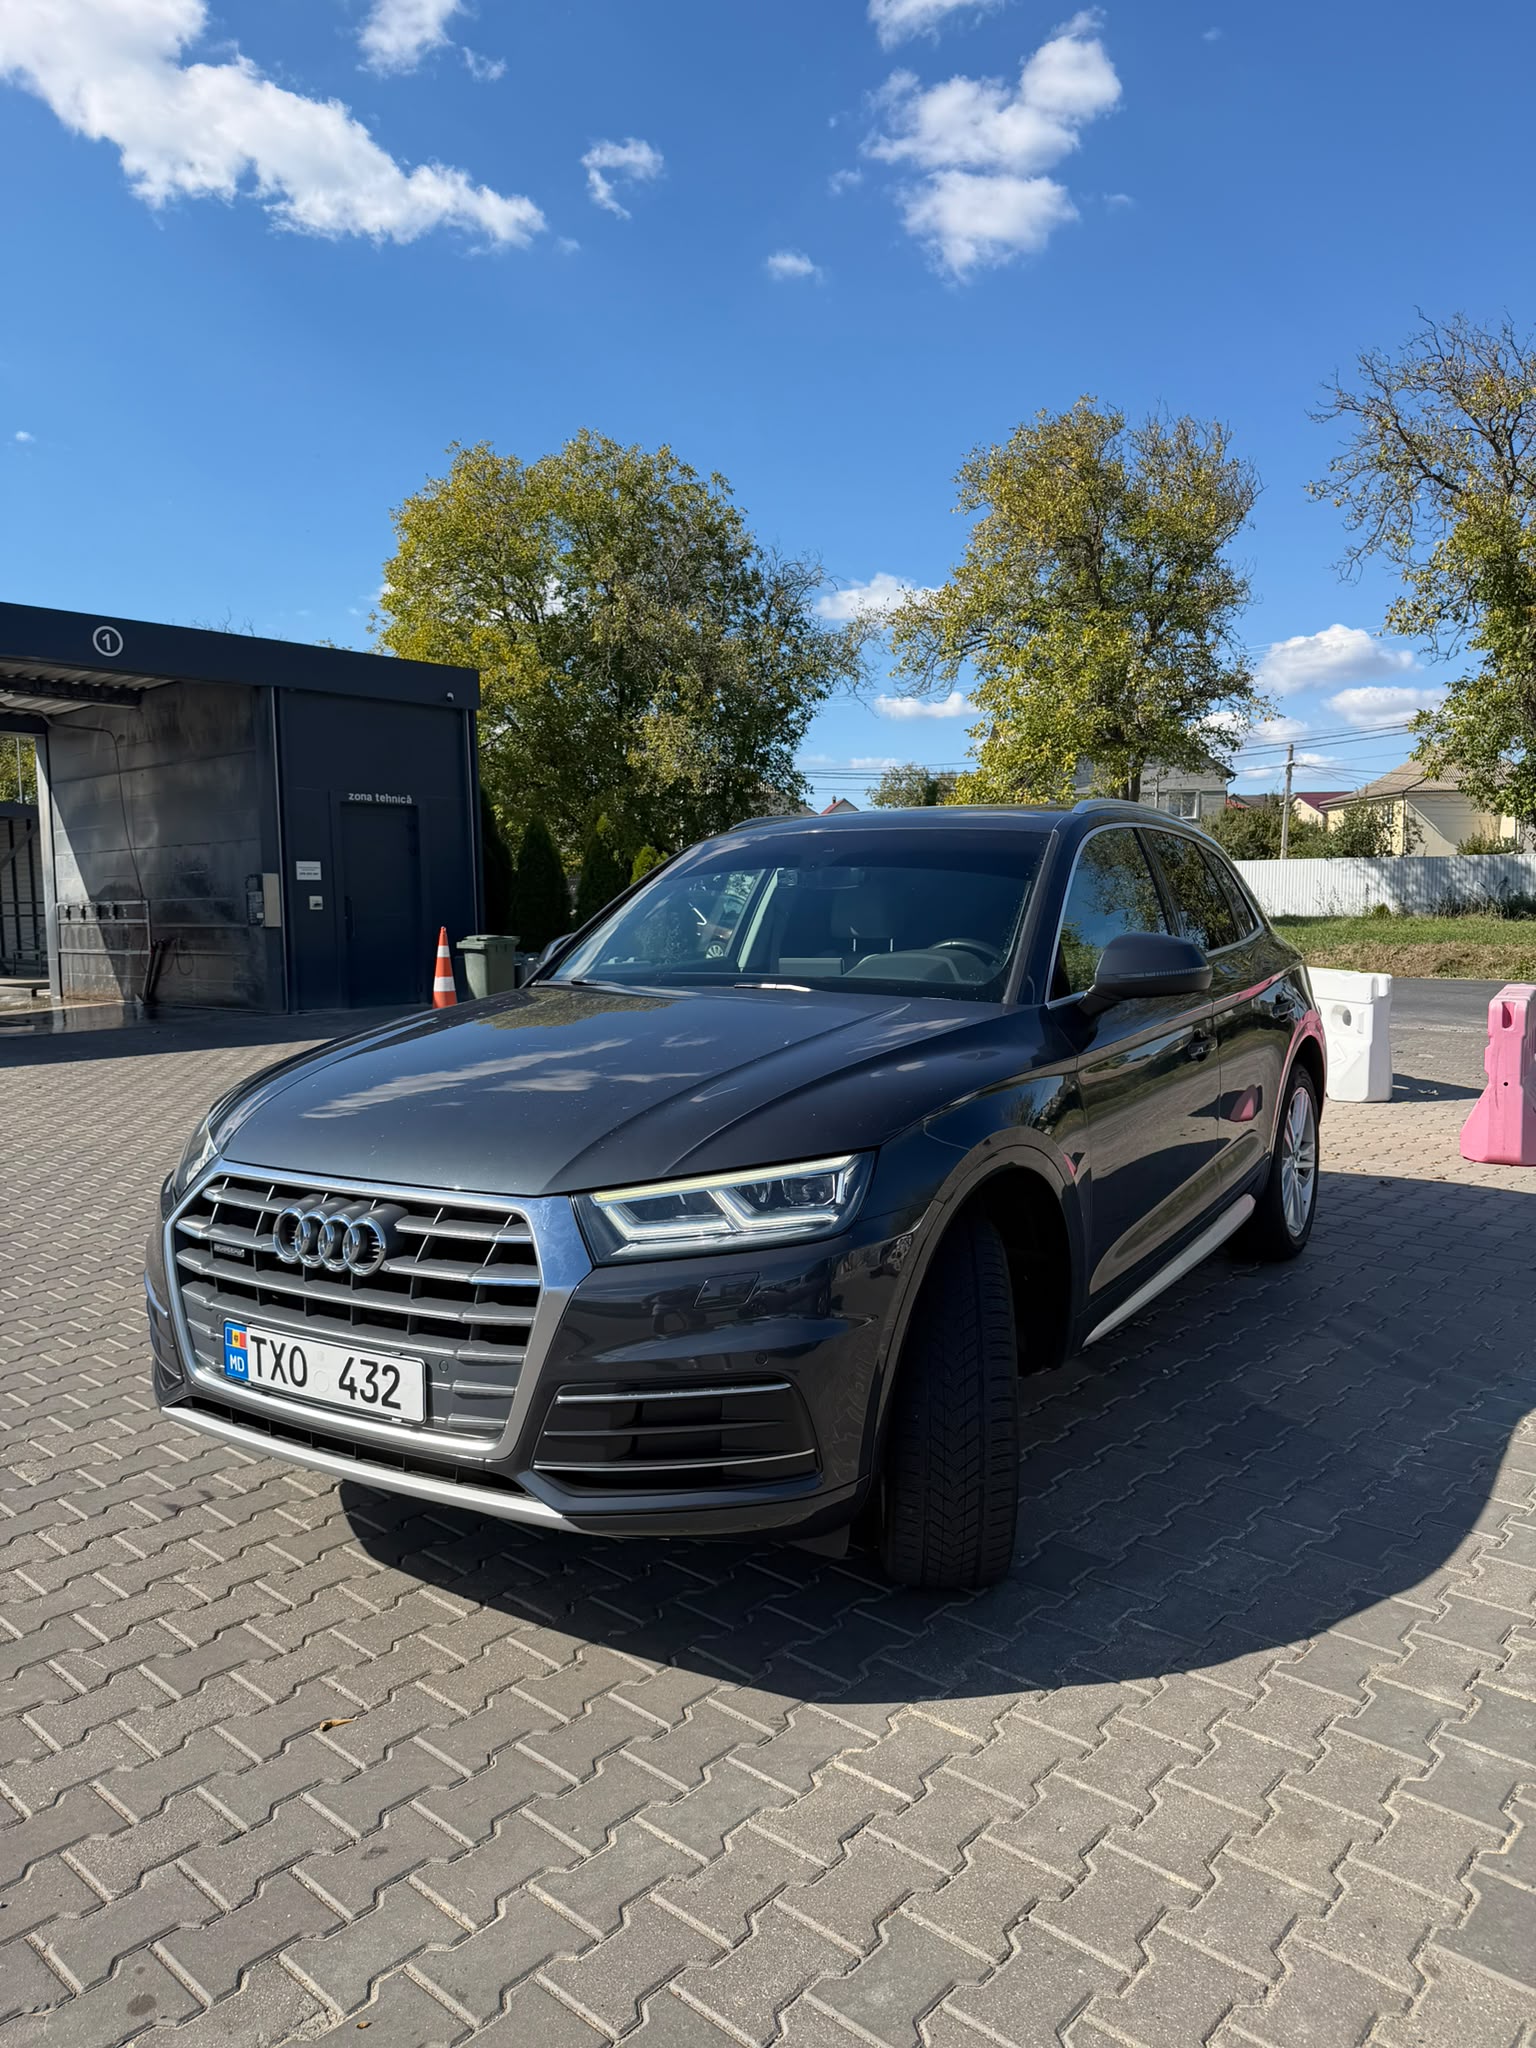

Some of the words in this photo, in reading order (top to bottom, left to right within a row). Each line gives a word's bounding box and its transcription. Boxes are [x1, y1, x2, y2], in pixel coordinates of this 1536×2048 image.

[102, 633, 111, 650] 1
[348, 793, 373, 801] zona
[230, 1354, 245, 1372] MD
[250, 1335, 308, 1388] TXO
[338, 1356, 401, 1410] 432
